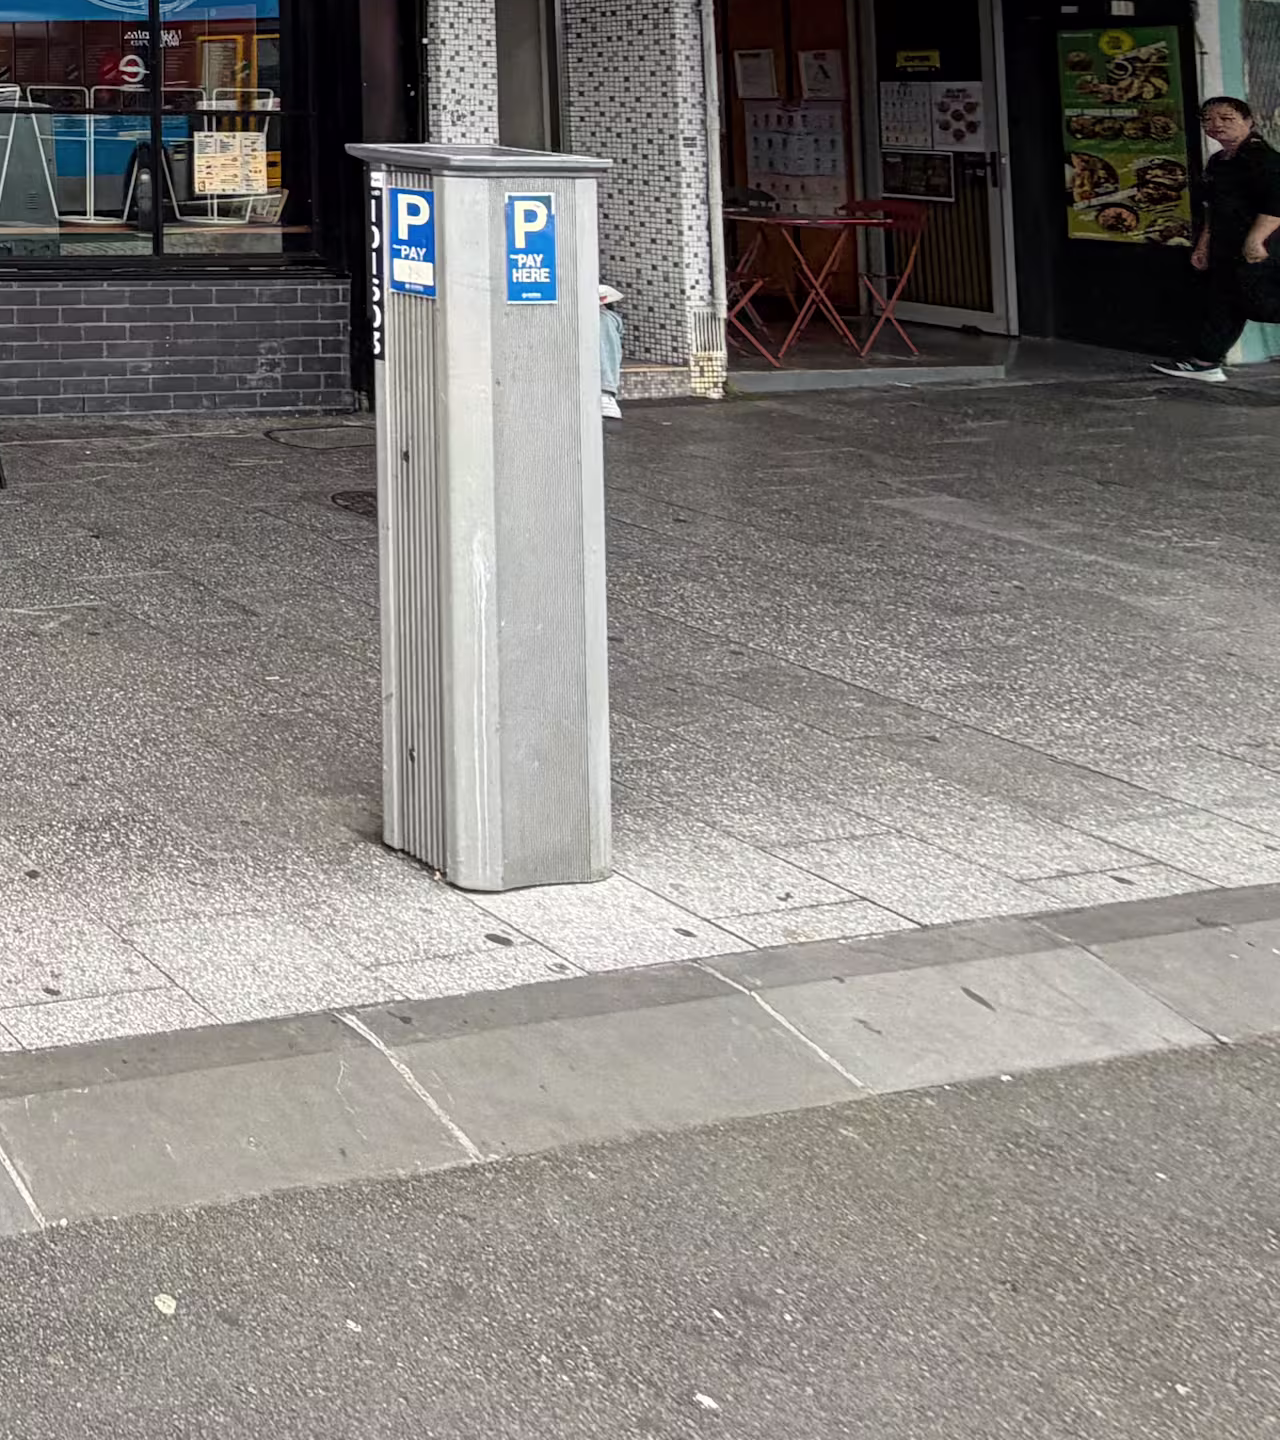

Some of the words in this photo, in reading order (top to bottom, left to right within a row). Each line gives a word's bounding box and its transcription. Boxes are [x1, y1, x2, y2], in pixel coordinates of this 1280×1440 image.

[397, 193, 430, 240] P
[514, 200, 548, 249] P
[400, 245, 426, 260] PAY
[516, 253, 543, 268] PAY
[512, 268, 550, 282] HERE
